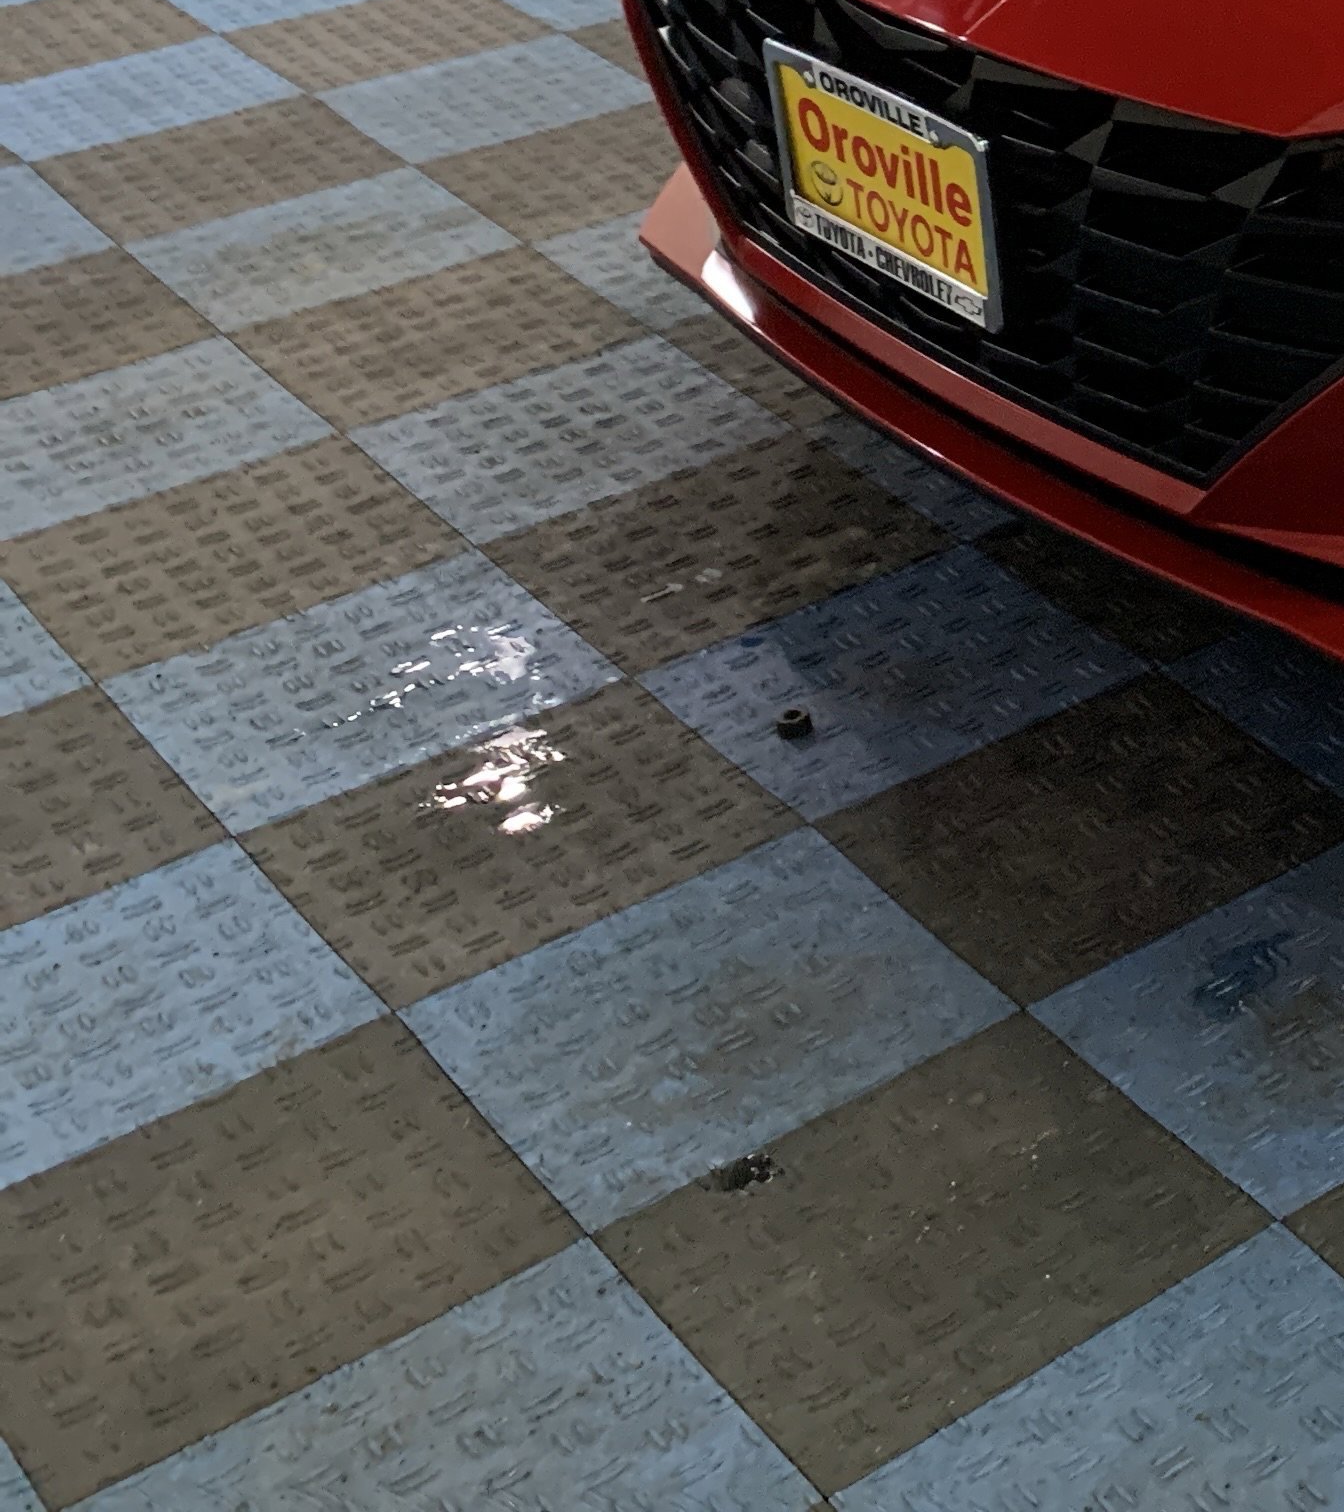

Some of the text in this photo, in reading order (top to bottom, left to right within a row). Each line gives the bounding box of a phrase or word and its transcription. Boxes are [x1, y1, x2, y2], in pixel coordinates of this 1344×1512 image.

[820, 72, 923, 135] OROVILLE
[798, 97, 973, 227] Oroville
[814, 213, 952, 305] TOYOTA CHEVROLET
[846, 178, 977, 285] TOYOTA
